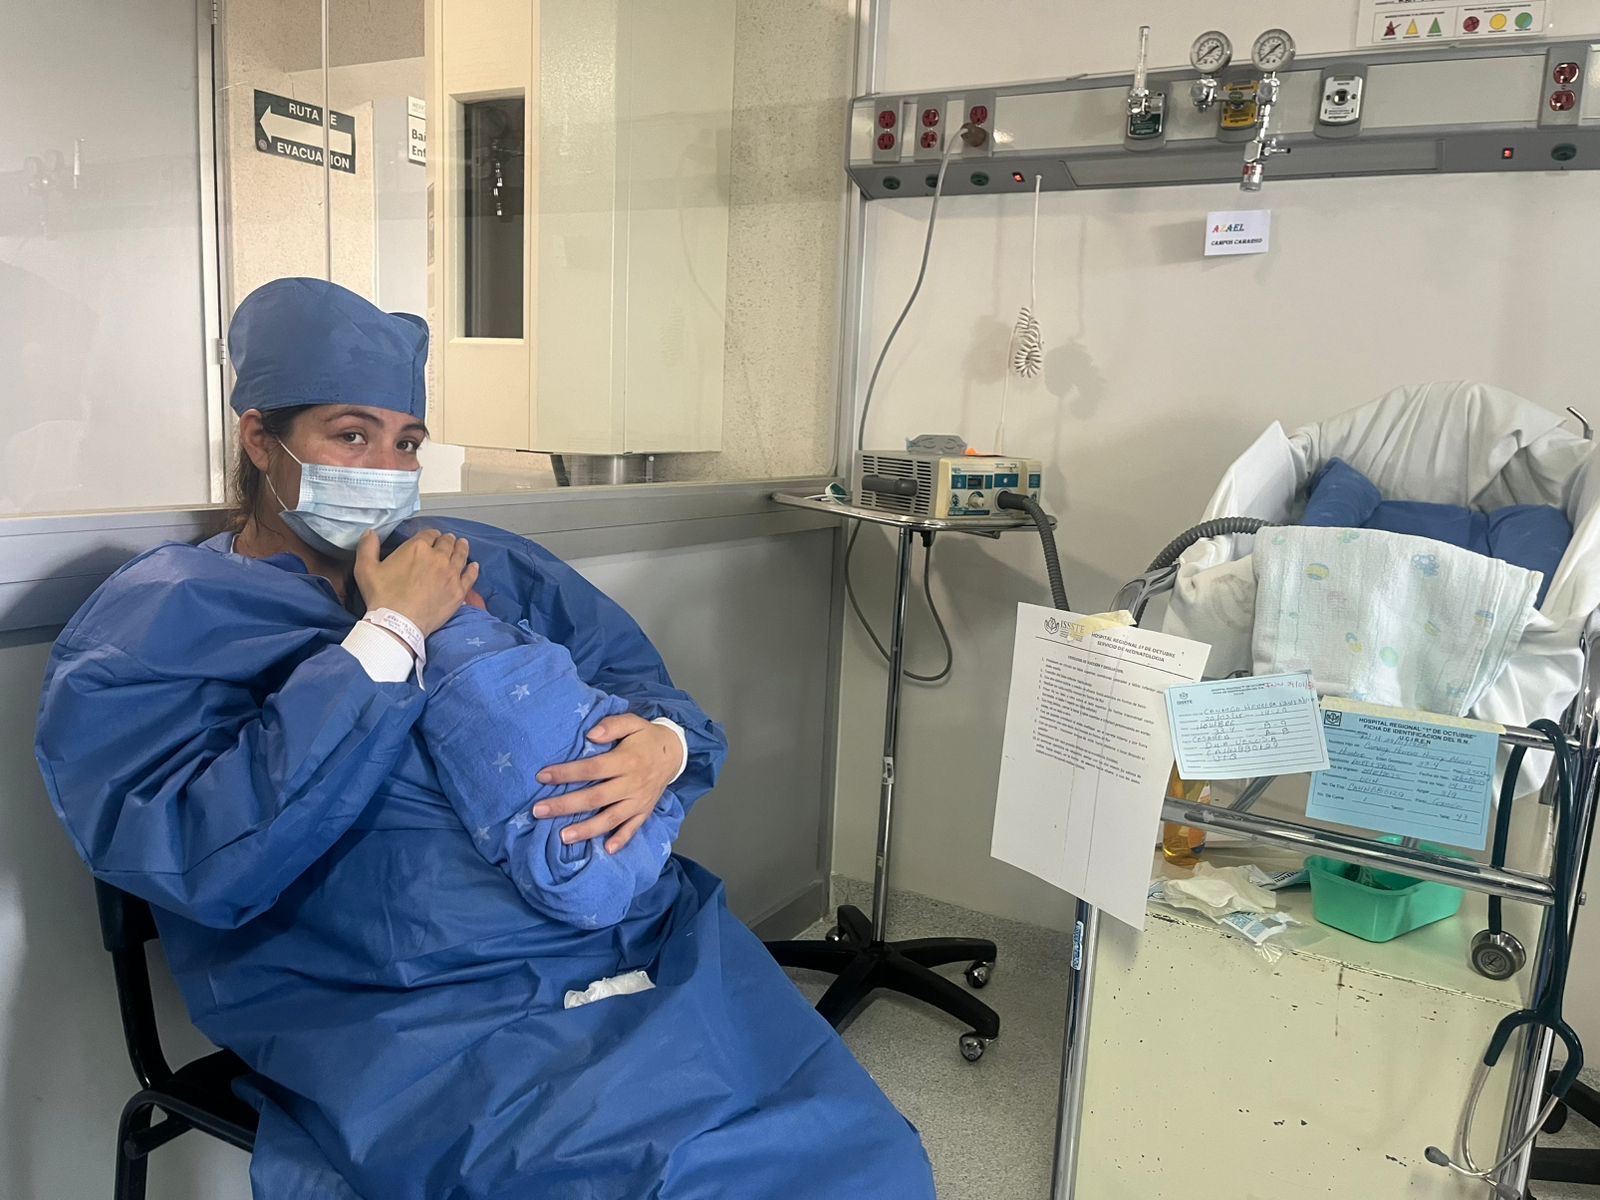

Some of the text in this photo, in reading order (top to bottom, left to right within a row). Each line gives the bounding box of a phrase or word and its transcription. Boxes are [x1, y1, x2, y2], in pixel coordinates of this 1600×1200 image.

[288, 102, 320, 121] RUTA
[277, 142, 350, 169] EVACUAION
[1212, 223, 1244, 233] AZAEL
[1060, 620, 1085, 634] ISSSTE
[1091, 631, 1112, 642] HOSPITAL
[1113, 637, 1137, 649] REGIONAL
[1152, 648, 1176, 659] OCTUBRE
[1097, 640, 1117, 650] SERVICIO
[1359, 717, 1389, 728] HOSPITAL
[1389, 721, 1421, 732] REGIONAL
[1363, 723, 1382, 732] FICHA
[1392, 728, 1442, 741] IDENTIFICACION
[1442, 735, 1456, 743] DEL
